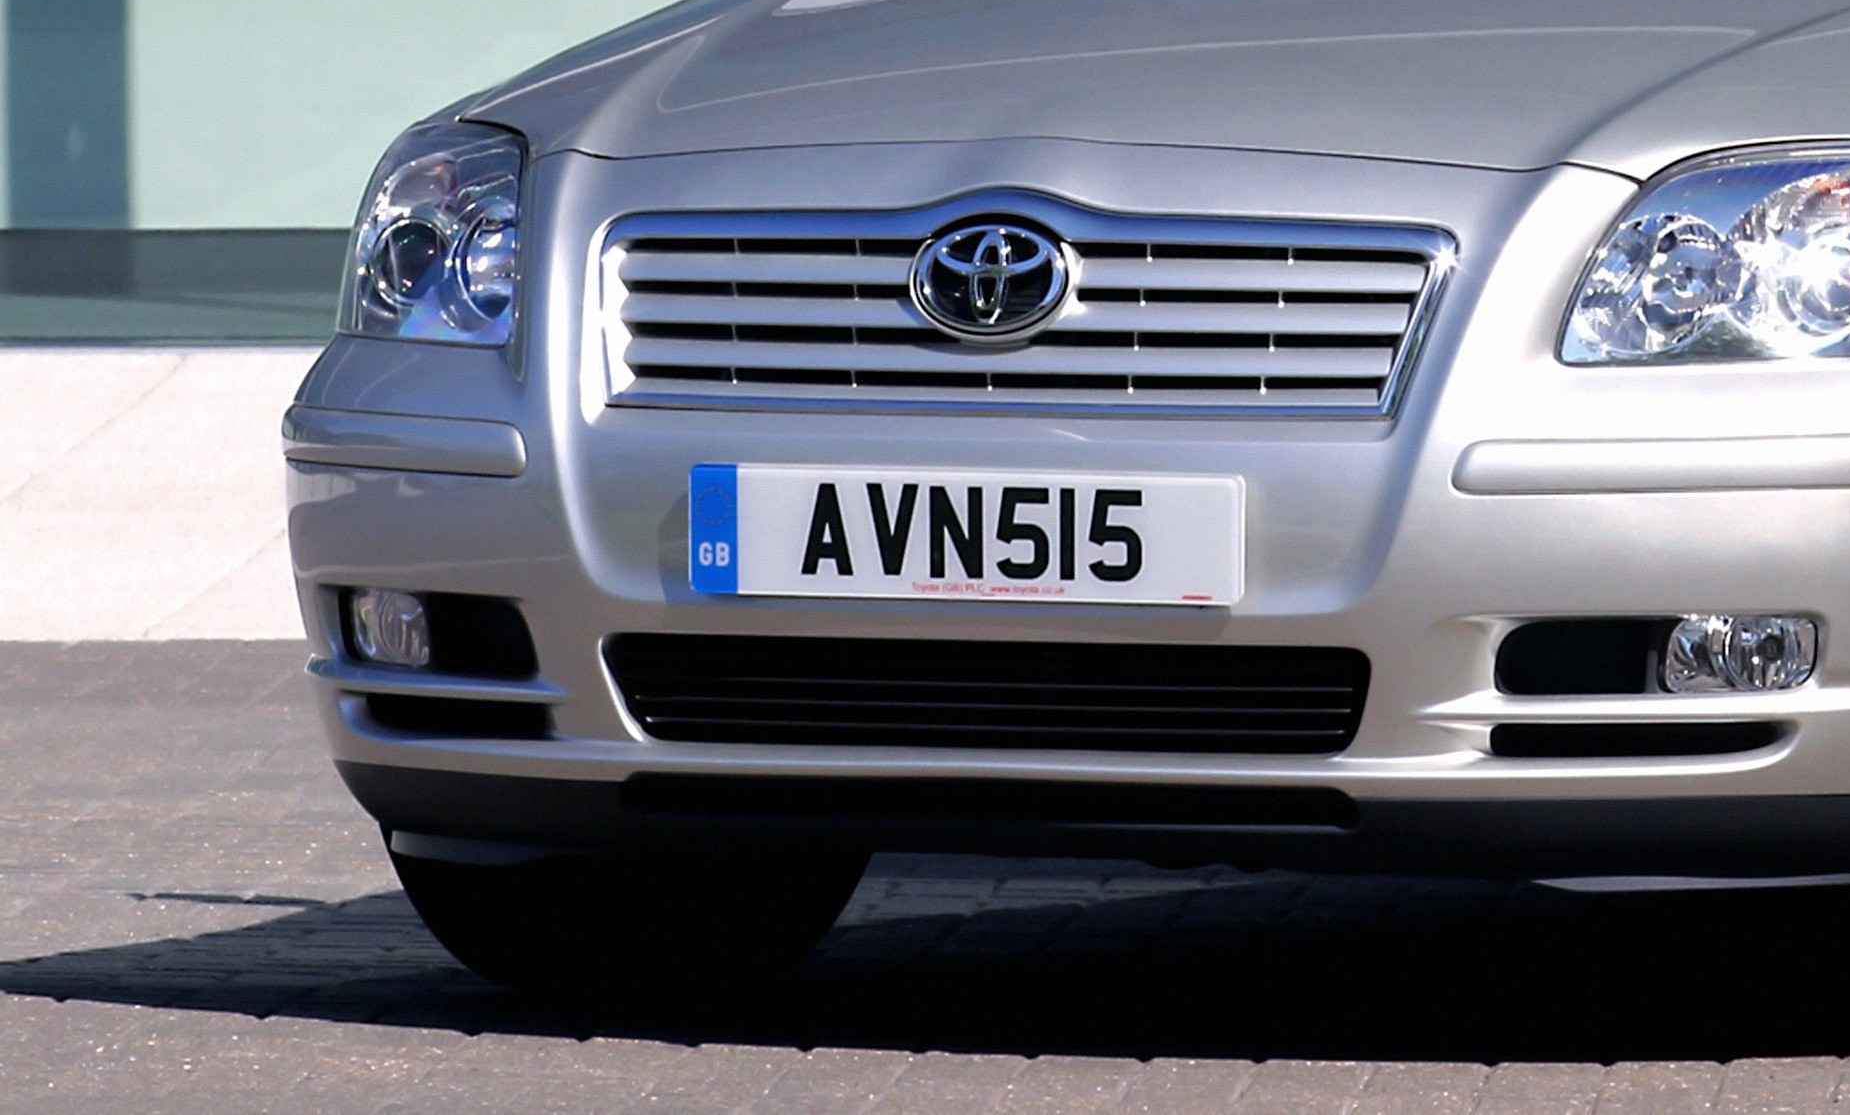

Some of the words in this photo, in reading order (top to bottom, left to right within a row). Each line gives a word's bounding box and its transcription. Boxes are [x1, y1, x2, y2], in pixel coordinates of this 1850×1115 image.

[801, 482, 1143, 582] AVN515
[698, 541, 730, 566] GB
[911, 581, 939, 594] Toyota
